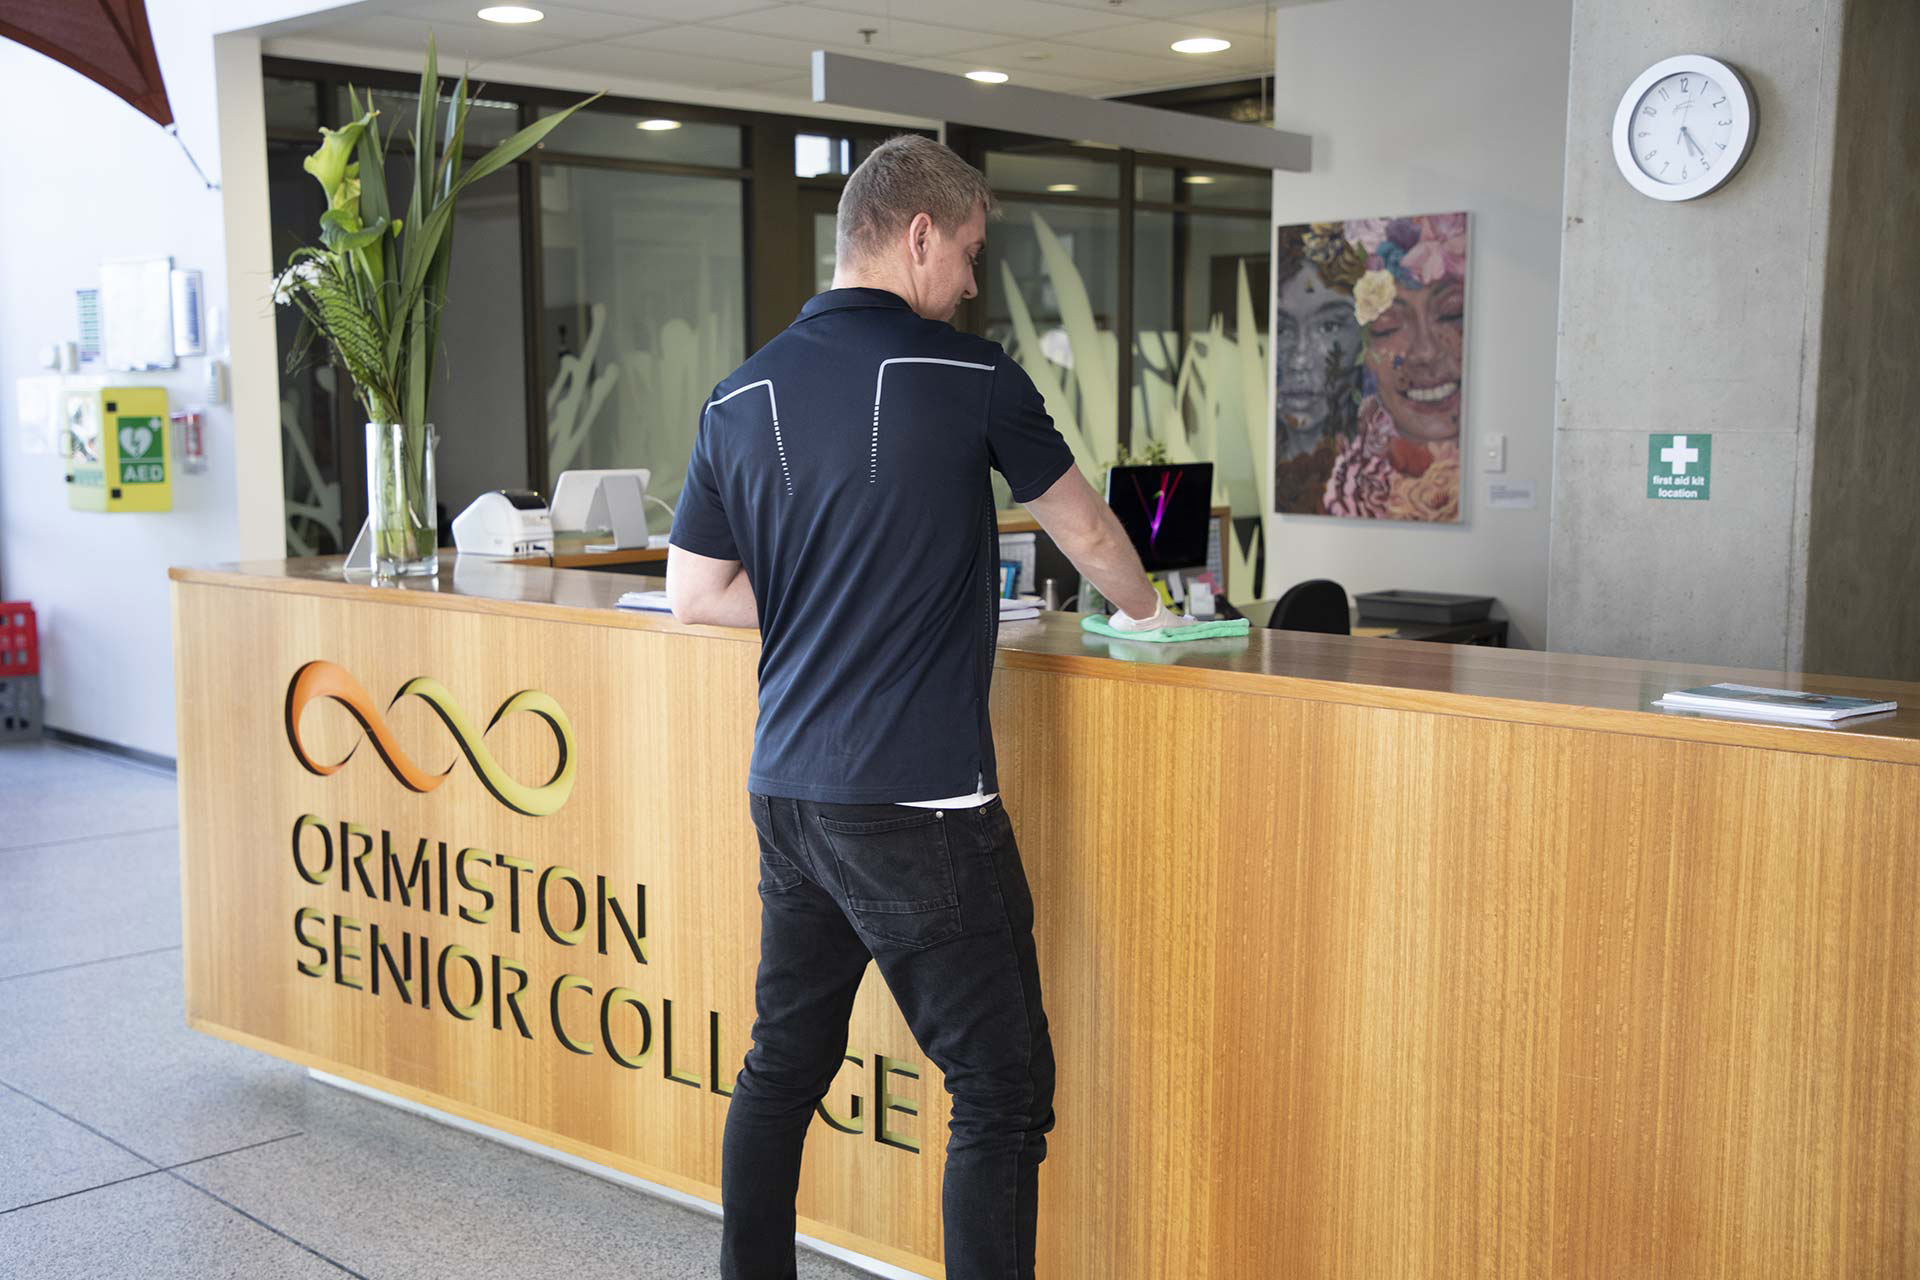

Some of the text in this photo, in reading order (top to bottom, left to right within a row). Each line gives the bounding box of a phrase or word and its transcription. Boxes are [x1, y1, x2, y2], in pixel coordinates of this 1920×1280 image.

[1680, 77, 1689, 93] 12
[1700, 80, 1709, 95] 1
[1658, 87, 1669, 101] 11
[1712, 96, 1726, 109] 2
[1642, 106, 1657, 118] 10
[1714, 142, 1727, 151] 4
[1645, 150, 1657, 161] 8
[1660, 161, 1670, 175] 7
[1700, 157, 1710, 171] 5
[1681, 164, 1688, 180] 6
[124, 464, 163, 481] AED
[1653, 475, 1704, 485] first aid kit
[1658, 488, 1698, 498] location
[292, 813, 648, 965] ORMISTON
[294, 907, 920, 1154] SENIOR COLLGE
